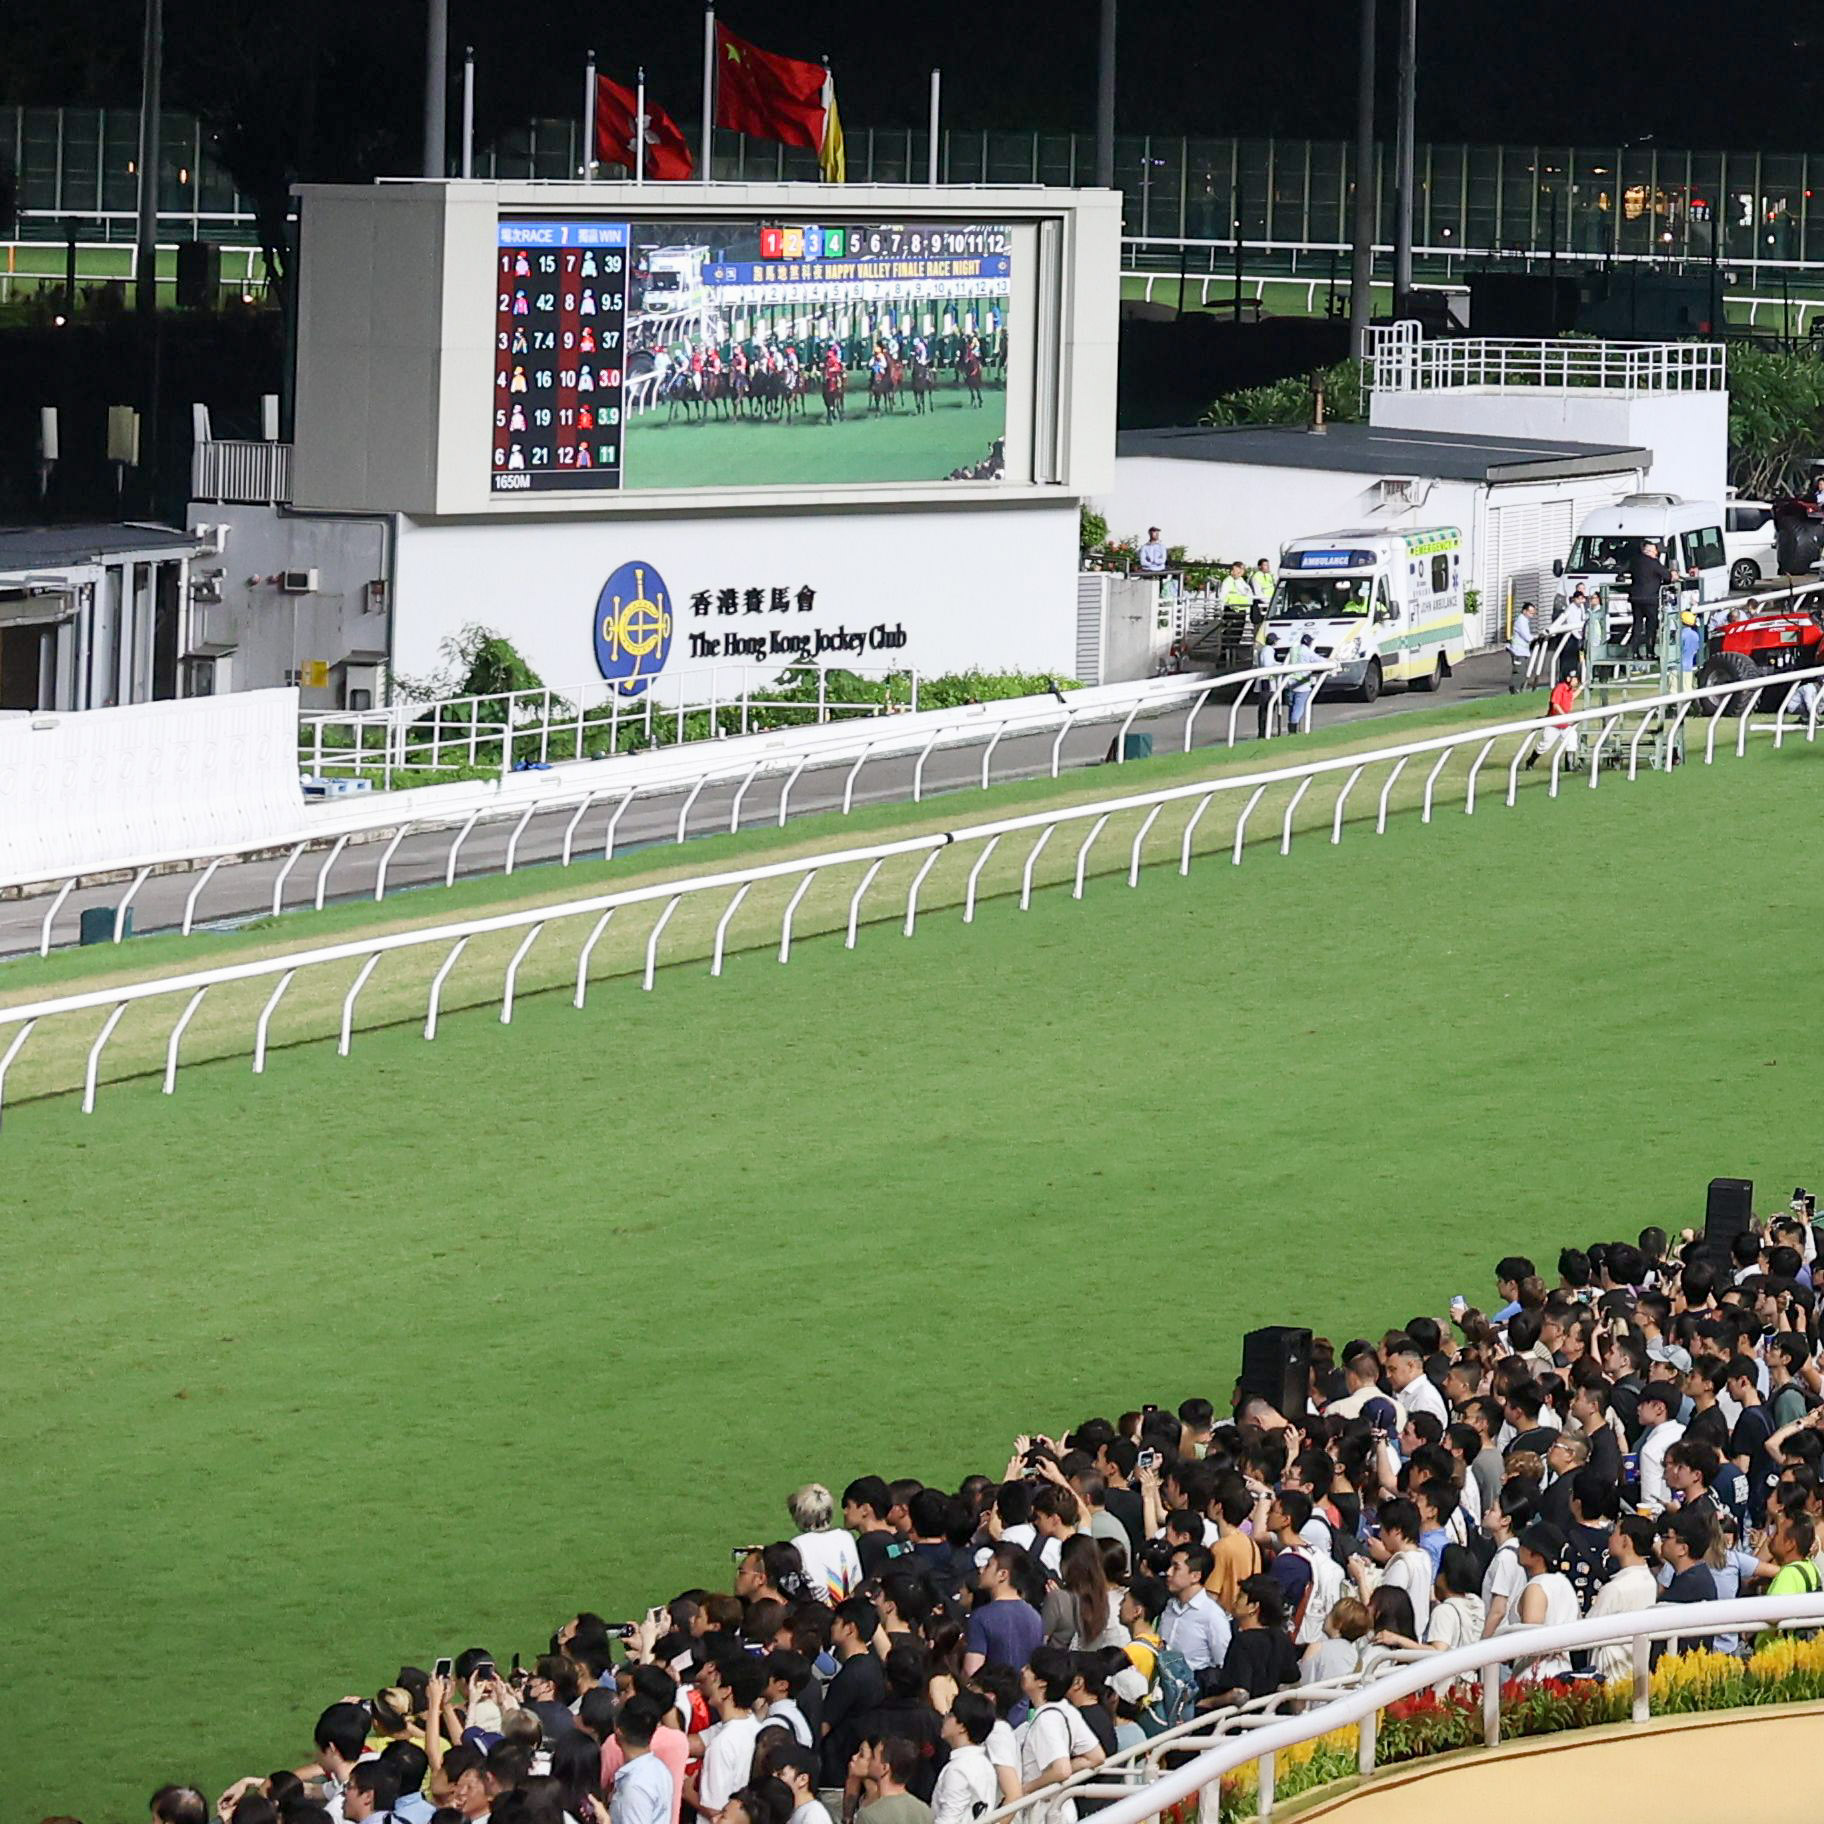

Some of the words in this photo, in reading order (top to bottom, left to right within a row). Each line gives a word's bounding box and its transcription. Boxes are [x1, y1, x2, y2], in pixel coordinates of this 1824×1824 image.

[522, 229, 553, 243] RACE
[599, 229, 622, 243] WIN
[768, 234, 777, 253] 1
[788, 234, 798, 253] 2
[809, 234, 819, 253] 3
[829, 234, 840, 253] 4
[849, 234, 860, 253] 5
[870, 234, 881, 253] 6
[891, 234, 901, 253] 7
[911, 234, 922, 253] 8
[931, 234, 942, 253] 9
[949, 234, 964, 253] 10
[968, 234, 983, 253] 11
[988, 234, 1004, 253] 12
[502, 256, 510, 272] 1
[539, 256, 555, 272] 15
[566, 255, 576, 272] 7
[604, 255, 622, 272] 39
[825, 263, 855, 280] HAPPY
[857, 262, 891, 279] VALLEY
[893, 261, 925, 277] FINALE
[926, 260, 951, 276] RACE
[952, 259, 981, 276] NIGHT
[500, 294, 509, 311] 2
[536, 294, 554, 311] 42
[565, 293, 575, 310] 8
[601, 293, 623, 311] 9.5
[498, 332, 508, 349] 3
[534, 332, 555, 349] 7.4
[563, 332, 573, 349] 9
[602, 331, 620, 349] 37
[497, 371, 507, 387] 4
[535, 370, 551, 387] 16
[560, 370, 576, 387] 10
[600, 369, 620, 387] 3.0
[496, 409, 506, 426] 5
[534, 408, 551, 426] 19
[559, 409, 573, 425] 11
[598, 407, 619, 425] 3.9
[495, 448, 505, 465] 6
[532, 447, 548, 464] 21
[557, 447, 574, 464] 12
[600, 445, 616, 463] 11
[495, 474, 531, 489] 1650M
[1301, 556, 1350, 567] AMBULANCE
[689, 584, 817, 617] 香港賽馬會
[688, 631, 720, 658] The
[723, 630, 766, 662] Hong
[769, 629, 811, 660] Kong
[812, 625, 867, 659] Jockey
[868, 622, 907, 649] Club
